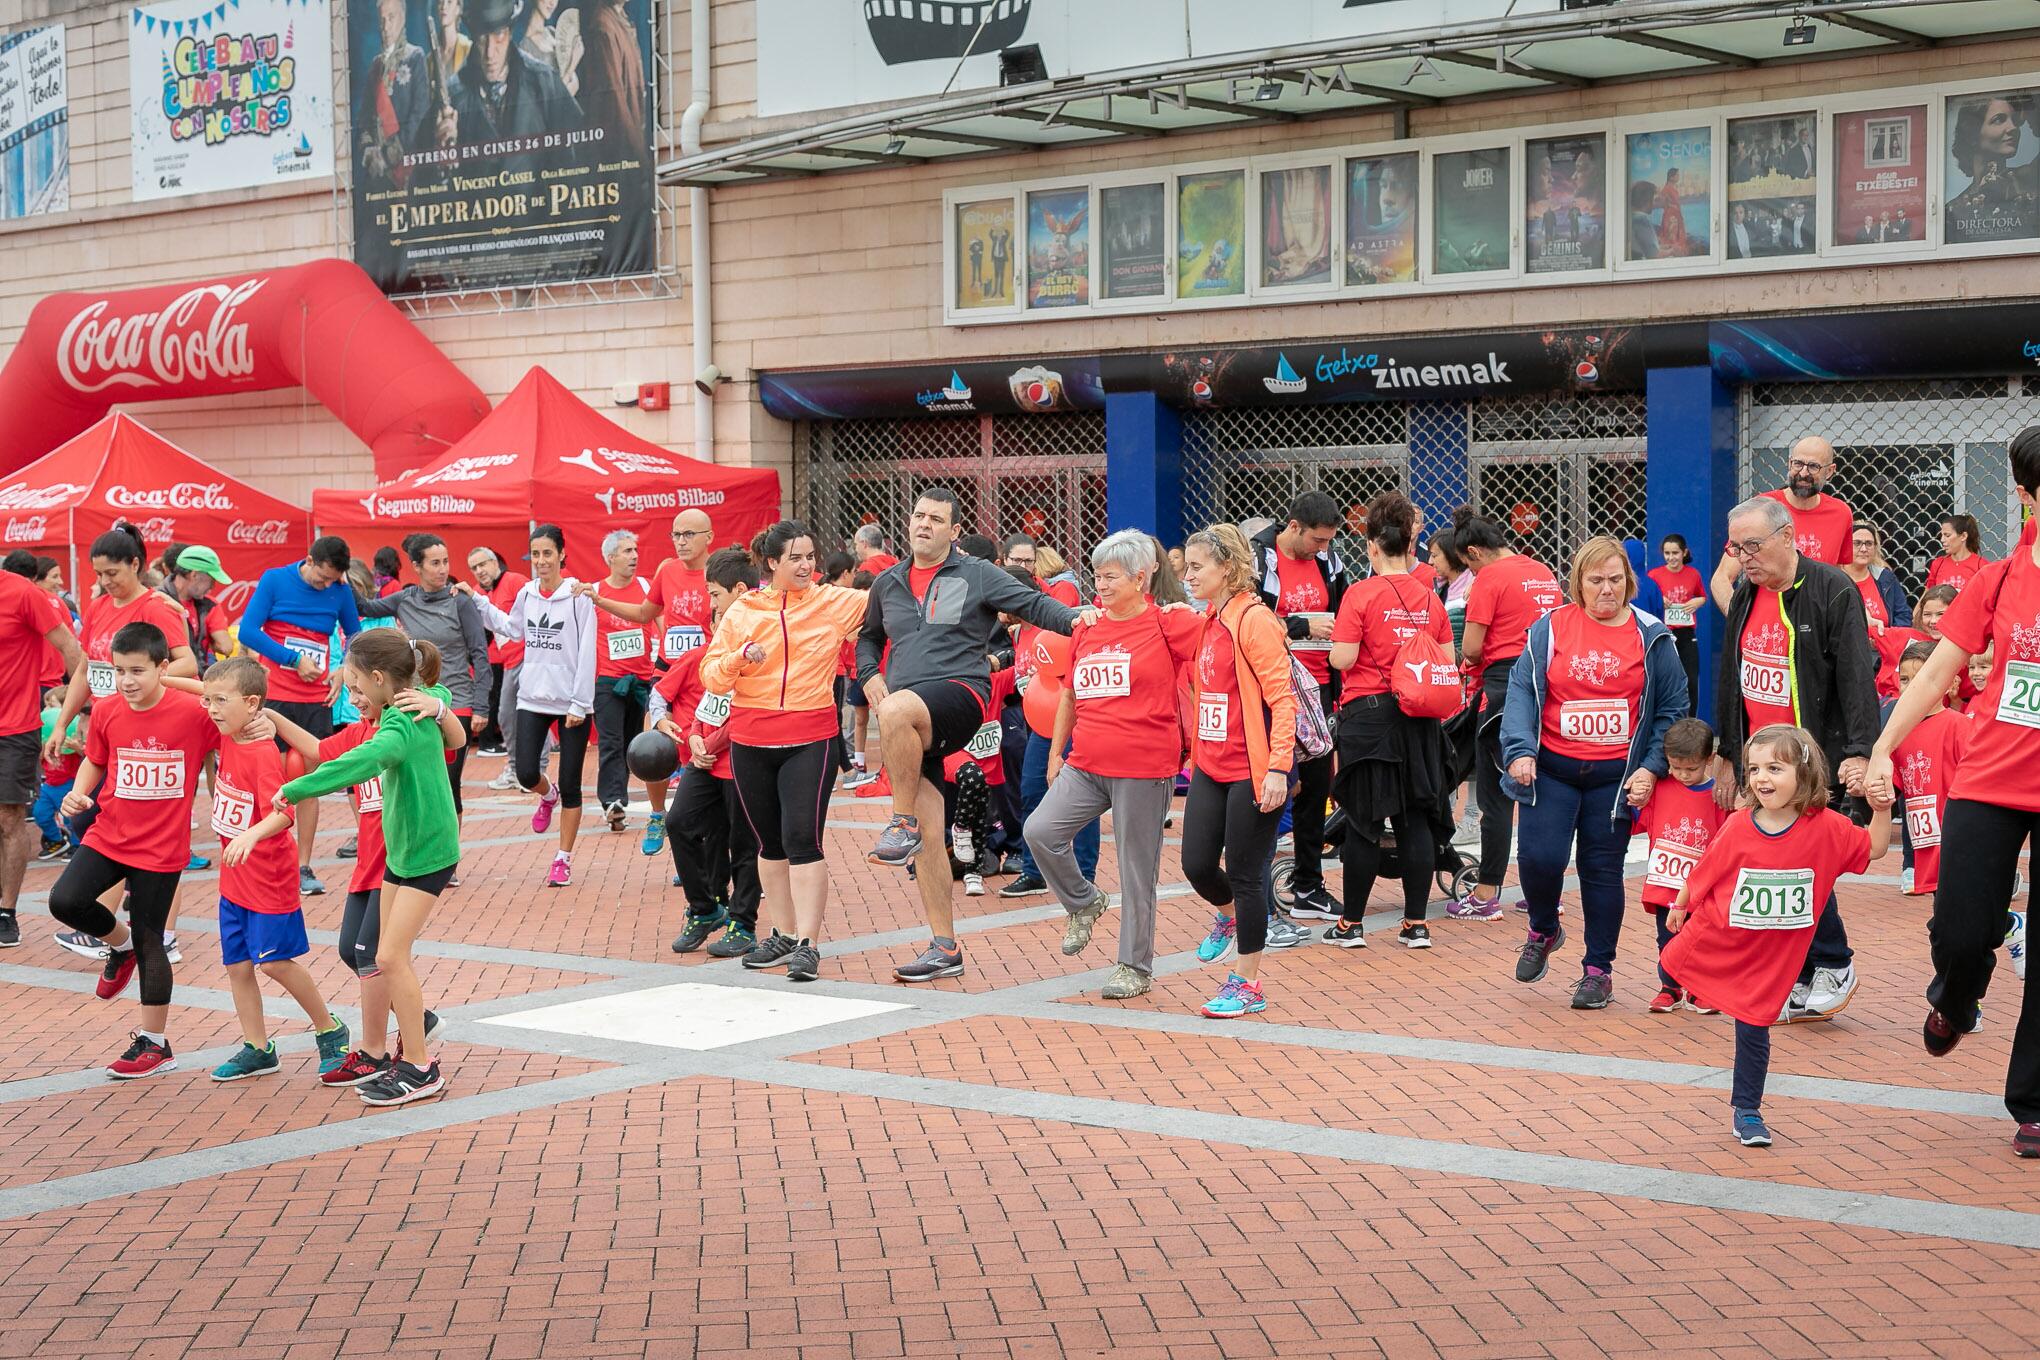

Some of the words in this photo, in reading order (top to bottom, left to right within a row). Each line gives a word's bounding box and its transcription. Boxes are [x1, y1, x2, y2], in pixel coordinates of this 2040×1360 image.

[257, 36, 278, 60] TU
[163, 59, 295, 118] CUMPLEAÑOS
[171, 110, 204, 140] CON
[204, 97, 290, 145] NOSOTROS
[403, 147, 458, 167] ESTRENO
[462, 145, 480, 162] EN
[483, 140, 522, 160] CINES
[525, 138, 540, 151] 26
[544, 134, 562, 148] DE
[566, 127, 605, 148] JULIO
[277, 162, 311, 173] zinemak
[1463, 167, 1494, 188] JOKER
[453, 176, 497, 192] VINCENT
[499, 170, 535, 187] CASSEL
[376, 212, 389, 226] EL
[389, 194, 529, 235] EMPERADOR
[530, 196, 546, 208] DE
[549, 182, 620, 216] PARIS
[575, 229, 605, 241] VIDOCQ
[1956, 217, 2022, 231] DIRECTORA
[1350, 240, 1365, 250] AD
[57, 276, 270, 392] Coca-Cola
[1315, 347, 1378, 383] Getxo
[1371, 352, 1512, 390] zinemak
[926, 401, 976, 412] zinemak
[104, 482, 234, 510] Coca-Cola
[377, 498, 429, 518] Seguros
[430, 495, 476, 513] Bilbao
[617, 493, 675, 513] Seguros
[677, 488, 725, 507] Bilbao
[227, 519, 290, 544] Coca-Cola
[526, 638, 563, 652] adidas
[612, 637, 641, 653] 2040
[669, 635, 703, 651] 1014
[1079, 665, 1123, 688] 3015
[1743, 663, 1785, 694] 3003
[968, 701, 1001, 751] 2006
[1568, 713, 1622, 736] 3003
[122, 763, 178, 788] 3015
[1739, 886, 1807, 916] 2013
